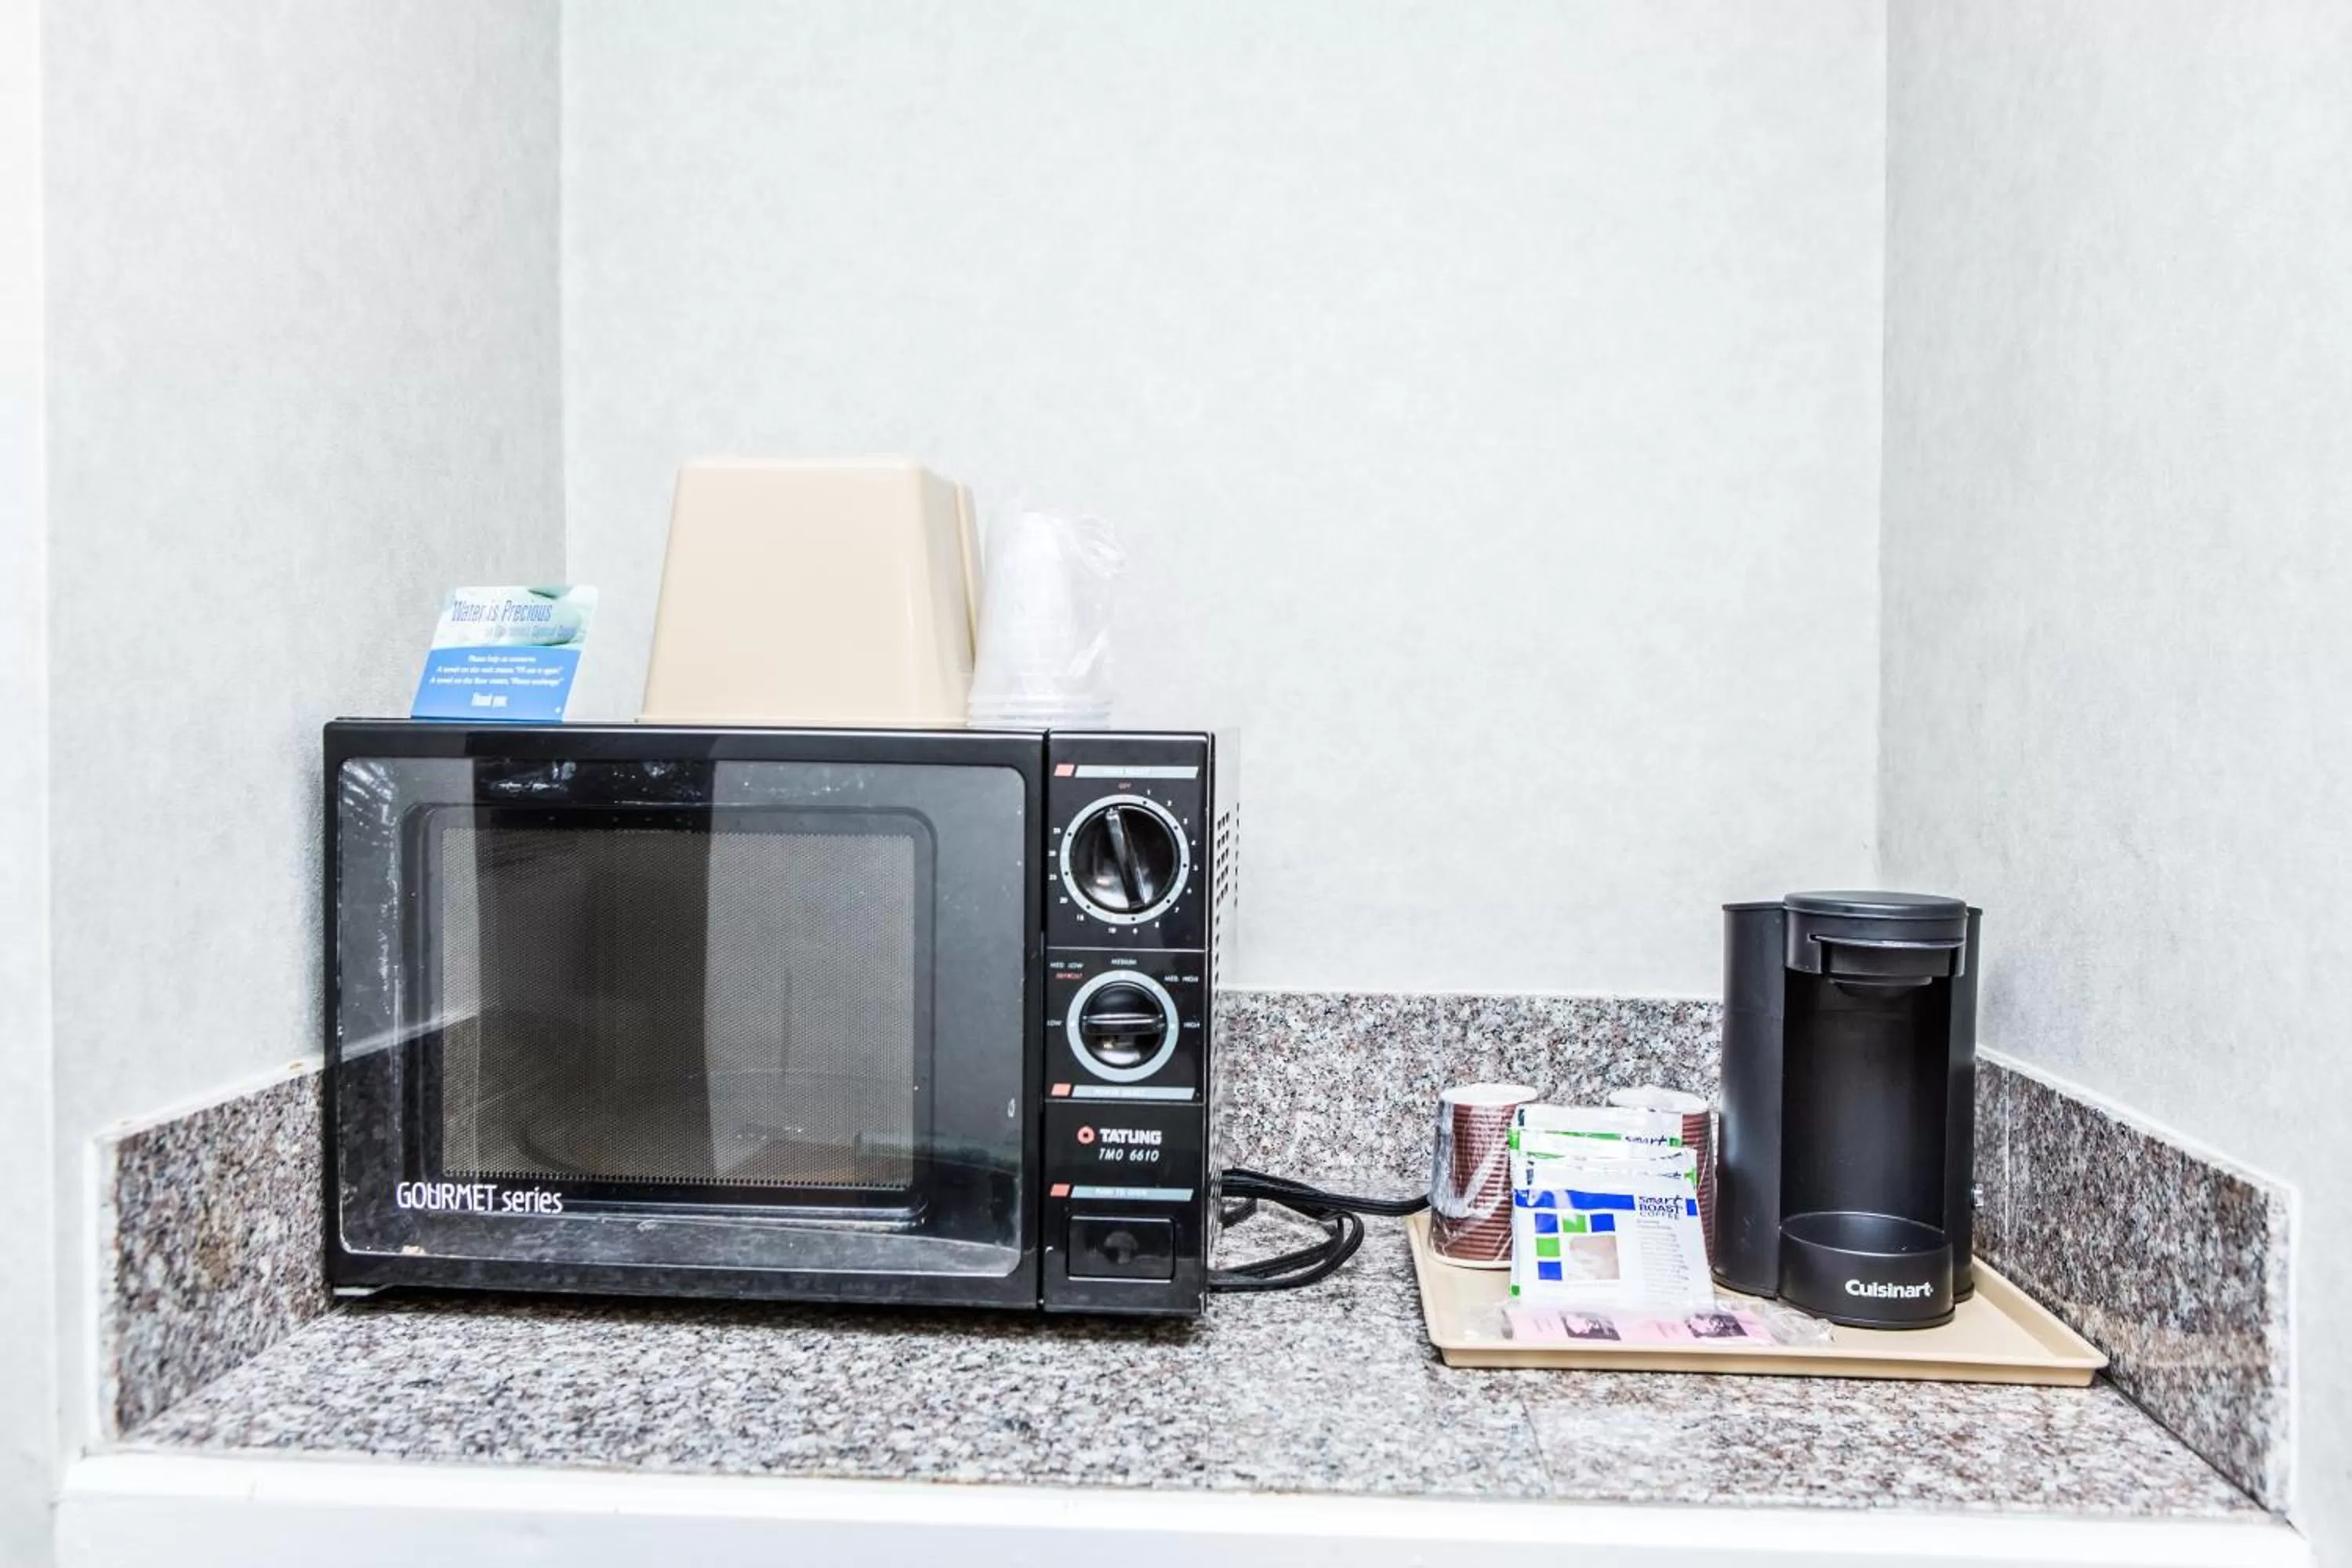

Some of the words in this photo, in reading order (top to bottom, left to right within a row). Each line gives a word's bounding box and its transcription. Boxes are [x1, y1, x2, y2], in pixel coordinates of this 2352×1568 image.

[452, 601, 486, 622] Water
[488, 599, 499, 622] is
[501, 600, 553, 622] Precious
[1099, 1127, 1162, 1145] TATUNG
[1098, 1147, 1124, 1161] TMO
[1129, 1149, 1160, 1163] 6610
[397, 1181, 498, 1211] GOURMET
[502, 1186, 564, 1214] series
[1845, 1279, 1931, 1298] Cuisinart
